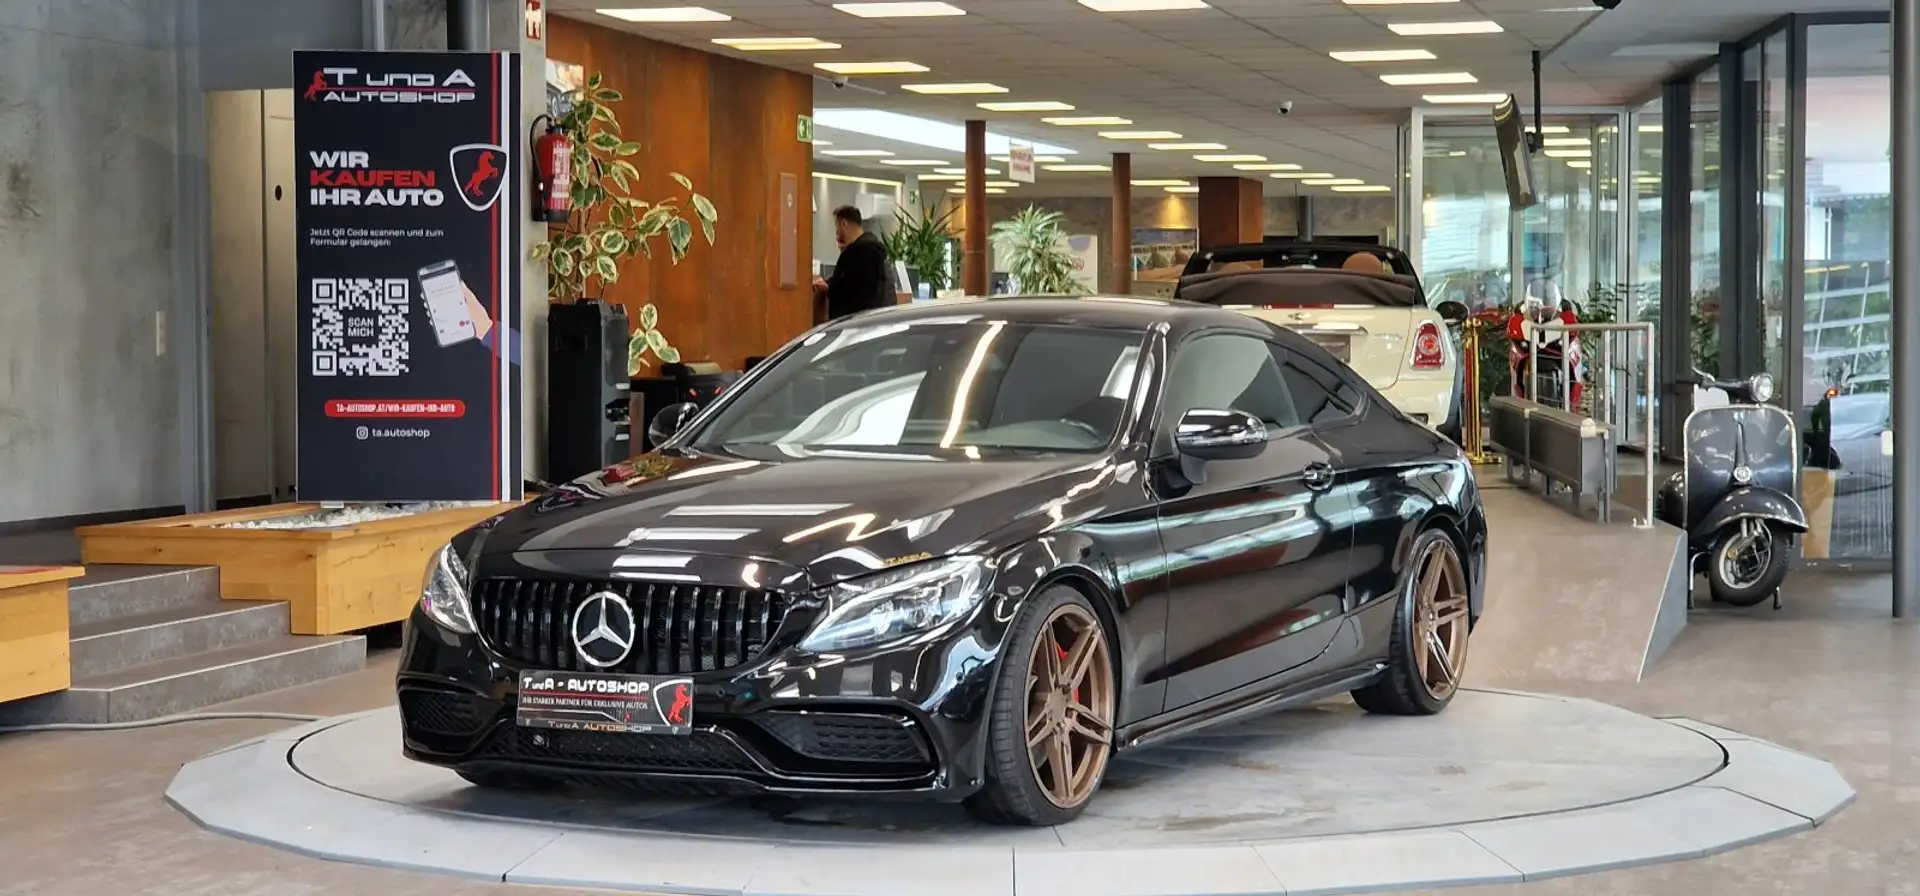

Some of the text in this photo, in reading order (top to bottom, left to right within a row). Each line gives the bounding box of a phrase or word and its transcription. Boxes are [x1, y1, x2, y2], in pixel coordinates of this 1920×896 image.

[322, 67, 358, 86] T
[442, 68, 475, 87] A
[323, 91, 476, 104] AUTOSHOP
[310, 151, 369, 168] WIR
[310, 170, 435, 187] KAUFEN
[310, 189, 444, 206] IHR AUTO
[310, 228, 330, 236] Jetzt
[332, 228, 345, 237] QR
[347, 228, 368, 236] Code
[407, 228, 424, 237] und
[425, 229, 444, 238] zum
[310, 238, 391, 248] Formular gelangen:
[348, 317, 374, 327] SCAN
[348, 327, 374, 337] MICH
[372, 428, 430, 438] ta.autoshop
[567, 679, 650, 694] AUTOSHOP
[626, 701, 648, 709] AUTOS
[583, 723, 652, 733] AUTOSHOP
